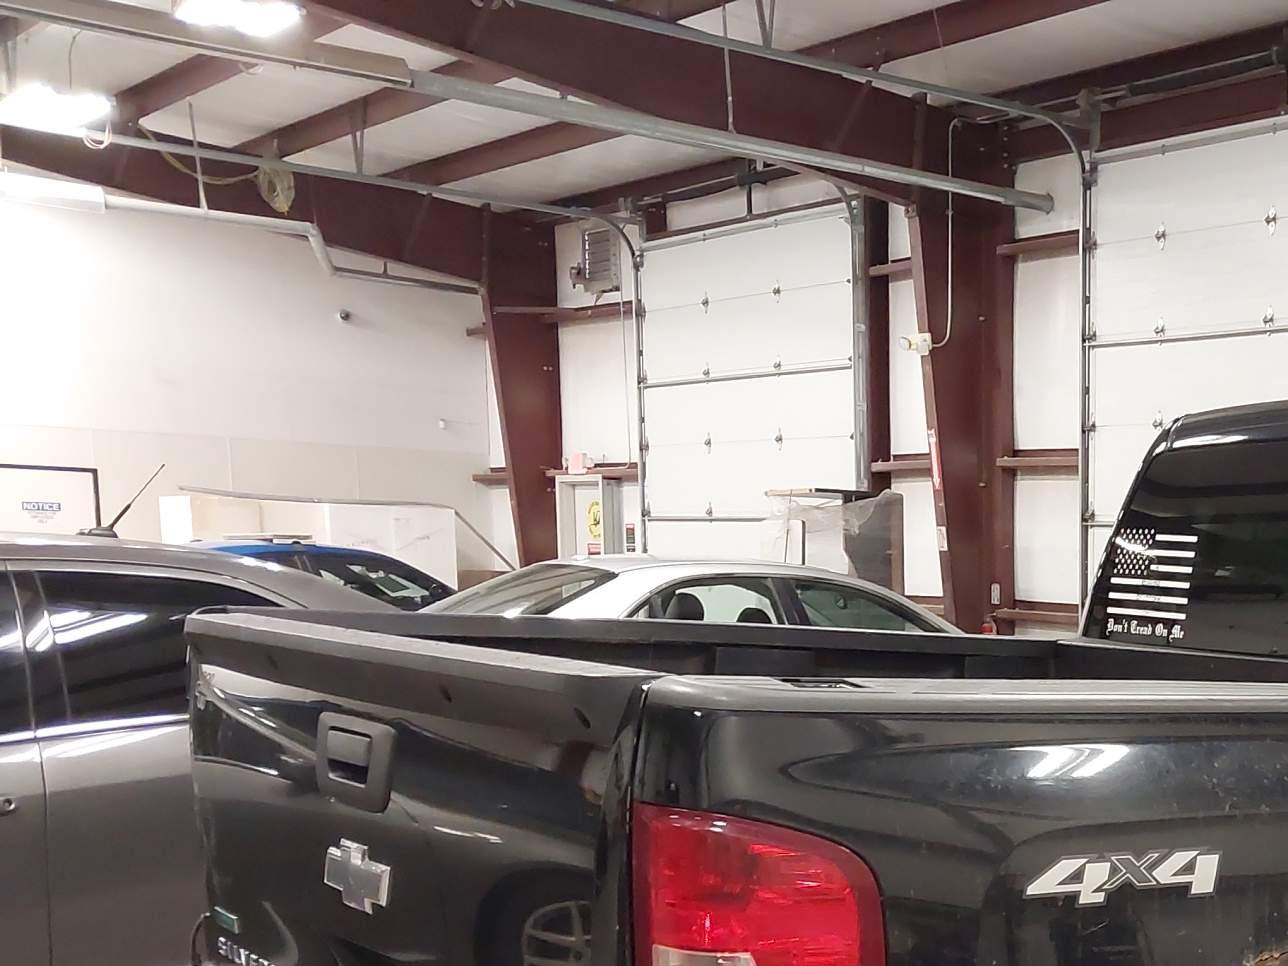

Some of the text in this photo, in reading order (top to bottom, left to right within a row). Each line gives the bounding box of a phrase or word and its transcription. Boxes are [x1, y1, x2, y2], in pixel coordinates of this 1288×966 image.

[1106, 618, 1128, 636] Don't
[1155, 623, 1168, 637] On
[1169, 624, 1184, 642] Me
